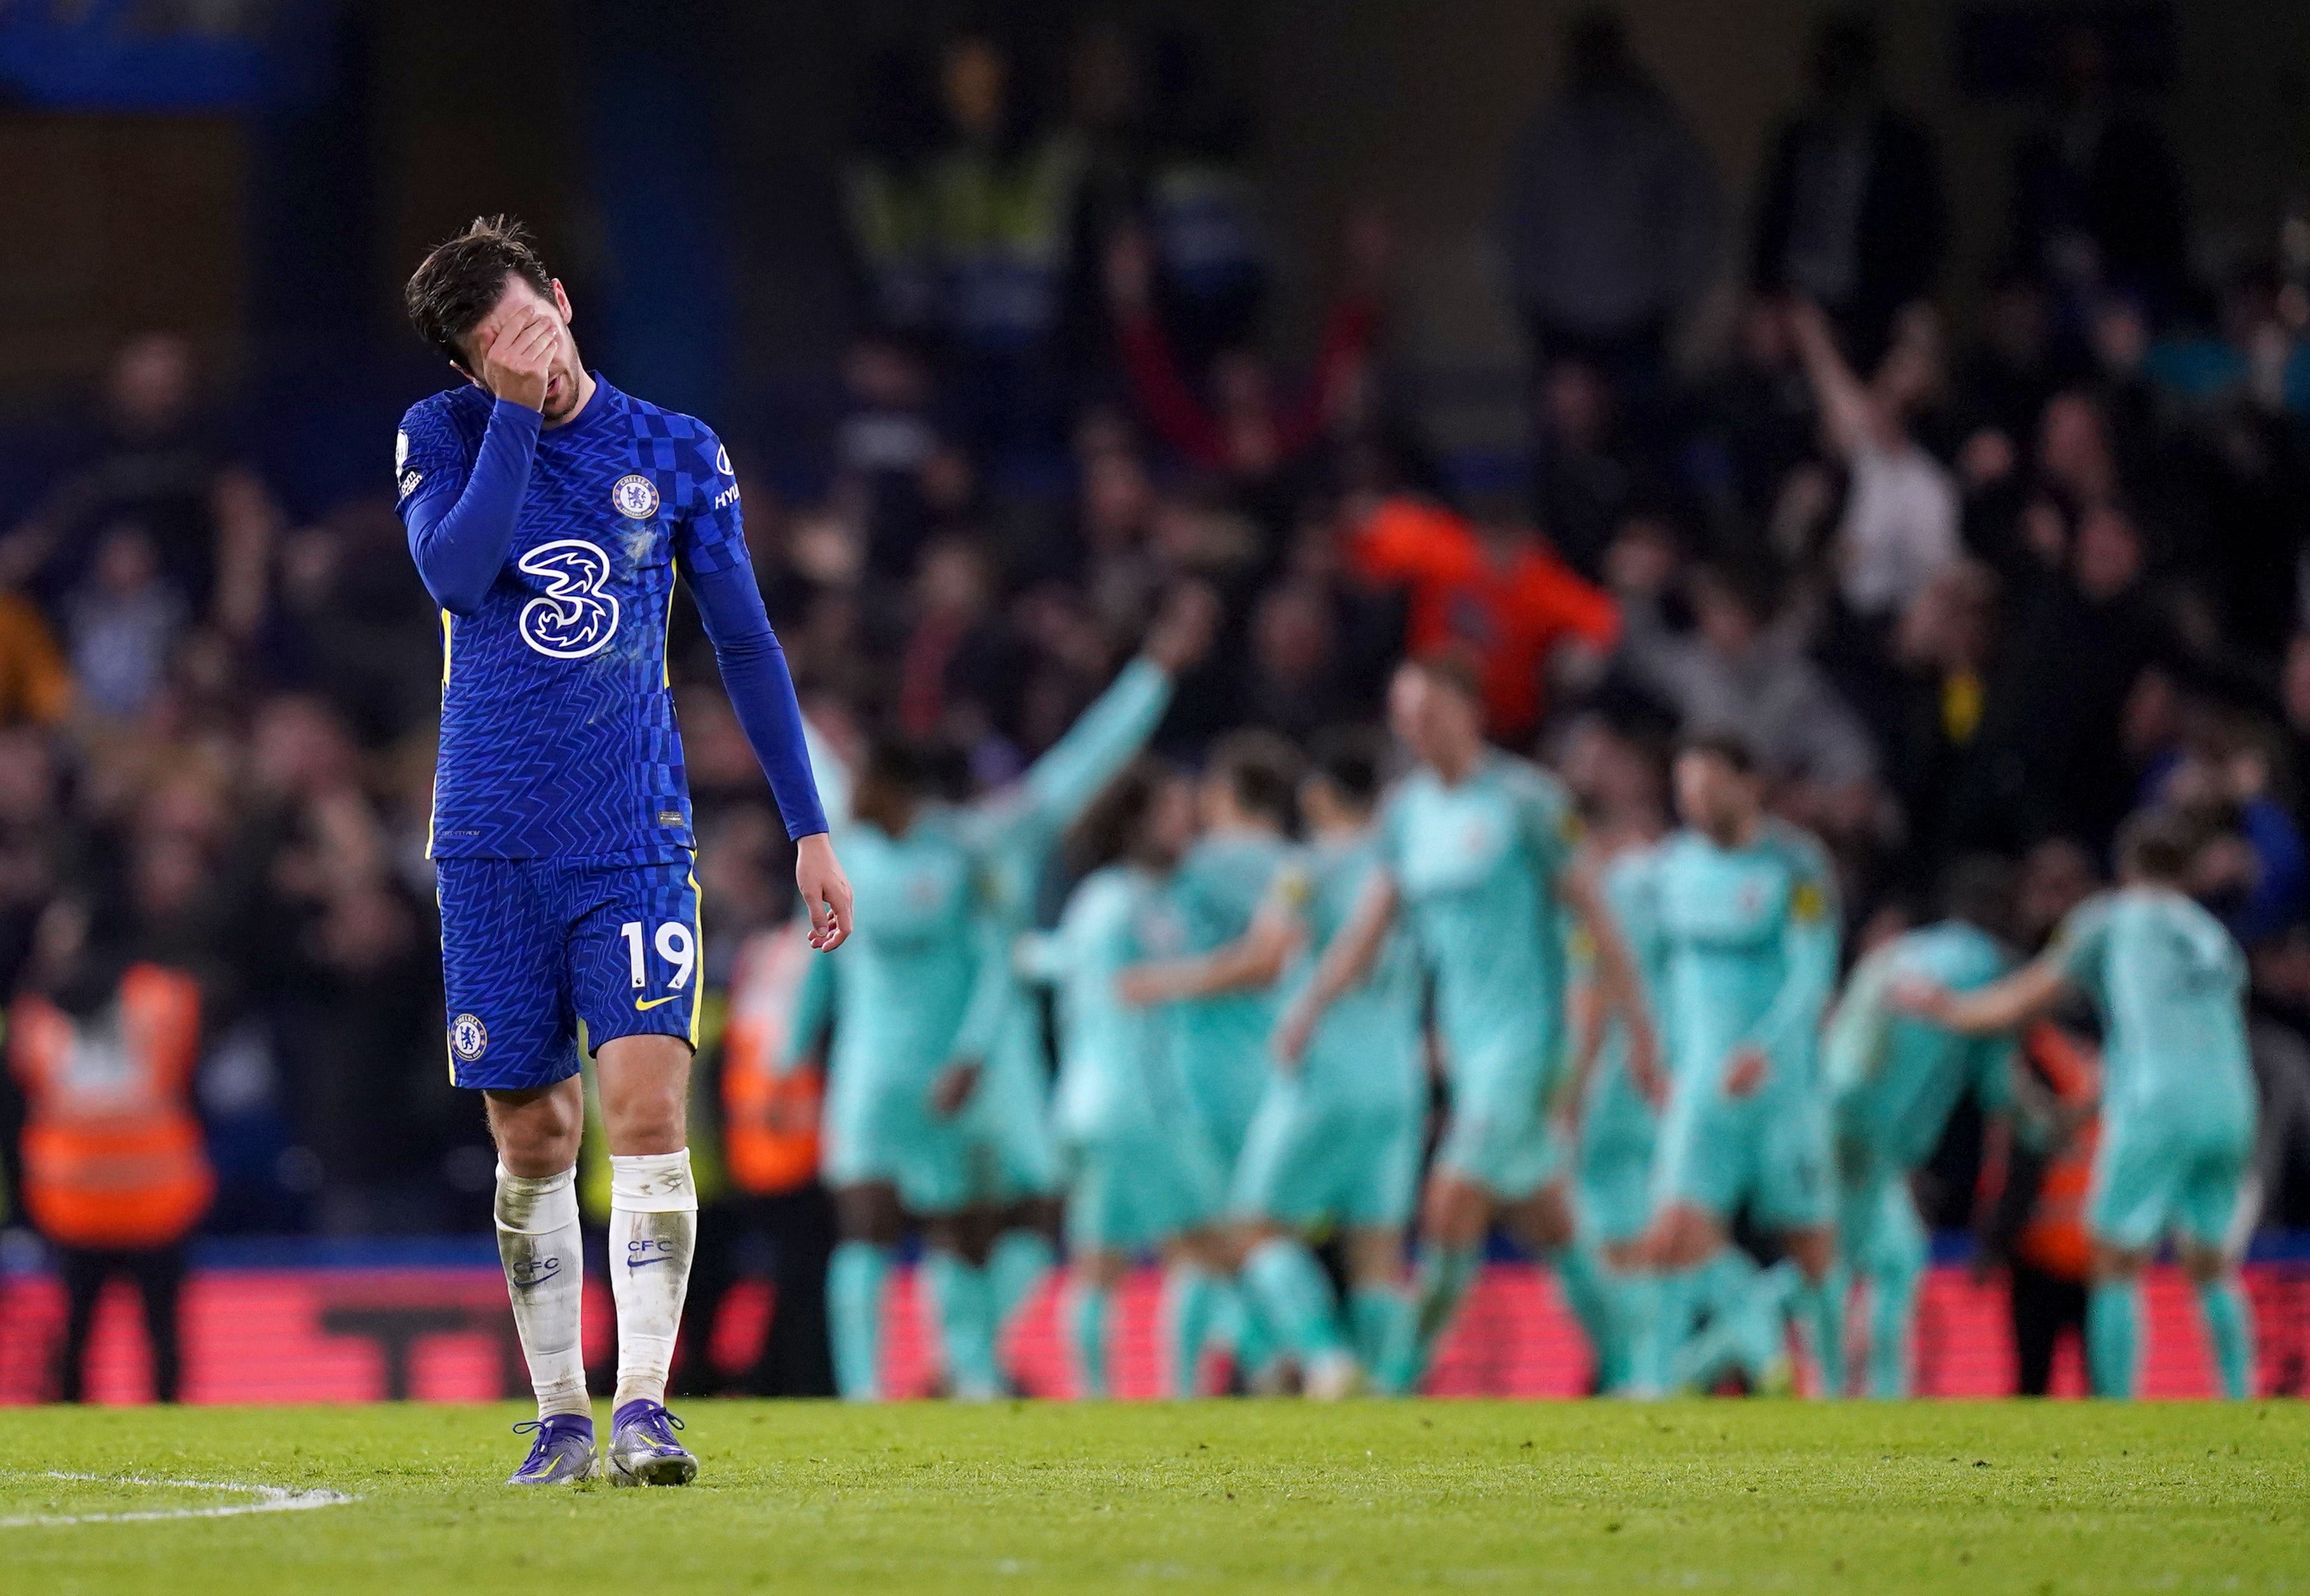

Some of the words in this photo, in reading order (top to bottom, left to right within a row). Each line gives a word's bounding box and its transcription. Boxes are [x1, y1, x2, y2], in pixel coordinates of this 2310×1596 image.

[620, 477, 650, 488] CHELSEA
[518, 539, 620, 658] 3
[620, 921, 694, 990] 19
[455, 1015, 478, 1026] CHELSEA
[627, 1240, 674, 1252] CFC
[512, 1258, 559, 1273] CFC
